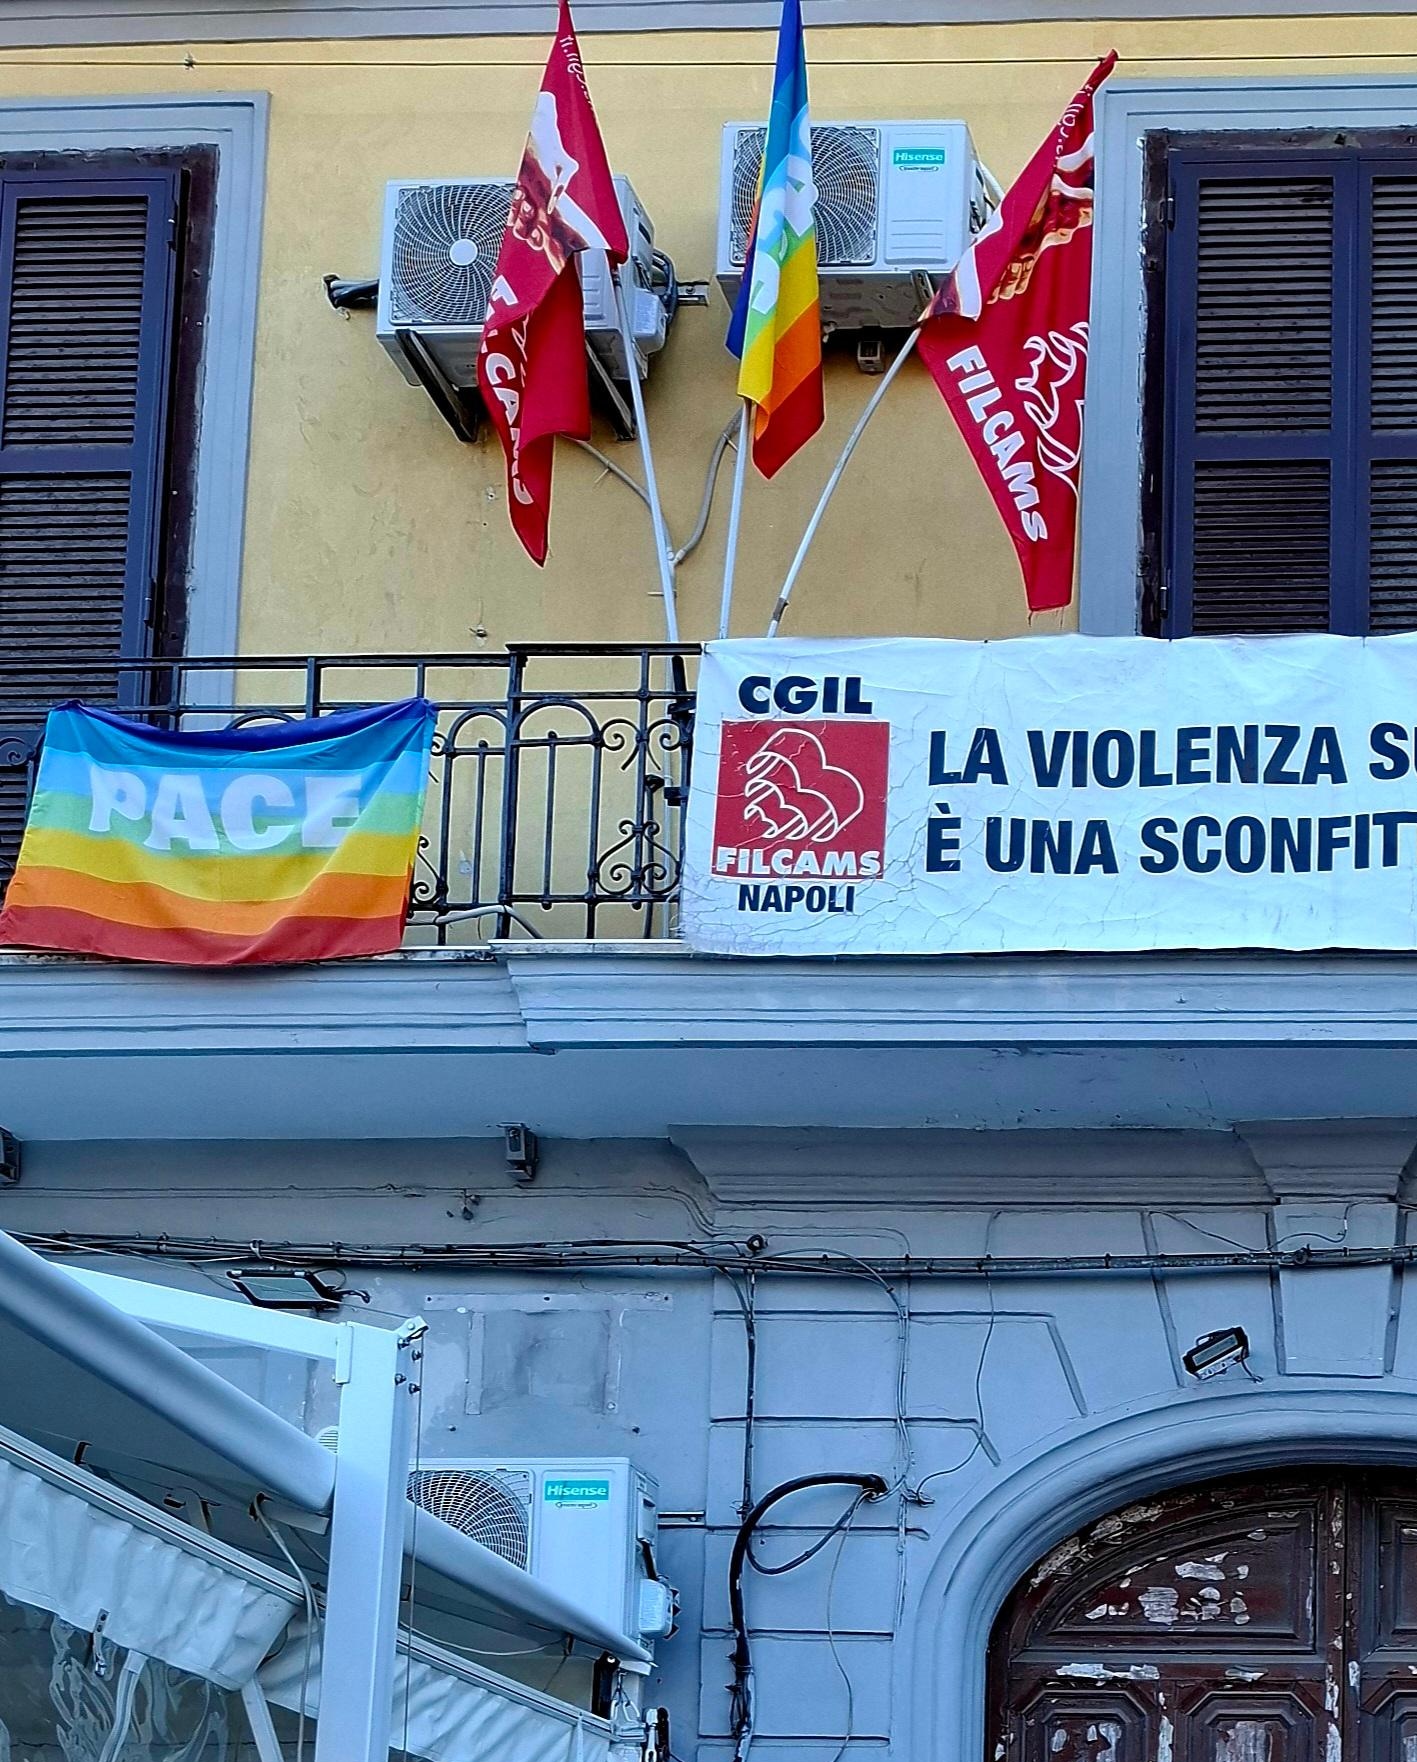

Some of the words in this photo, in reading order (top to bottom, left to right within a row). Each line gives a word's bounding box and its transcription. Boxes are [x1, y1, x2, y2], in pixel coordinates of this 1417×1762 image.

[895, 151, 944, 164] Hisense
[945, 344, 1049, 542] FILCAMS
[737, 675, 873, 715] CGIL
[928, 726, 1009, 787] LA
[1026, 724, 1348, 789] VIOLENZA
[87, 763, 363, 852] PACE
[925, 803, 962, 874] È
[984, 815, 1120, 876] UNA
[715, 845, 881, 877] FILCAMS
[737, 883, 855, 914] NAPOLI
[546, 1484, 607, 1496] Hisense
